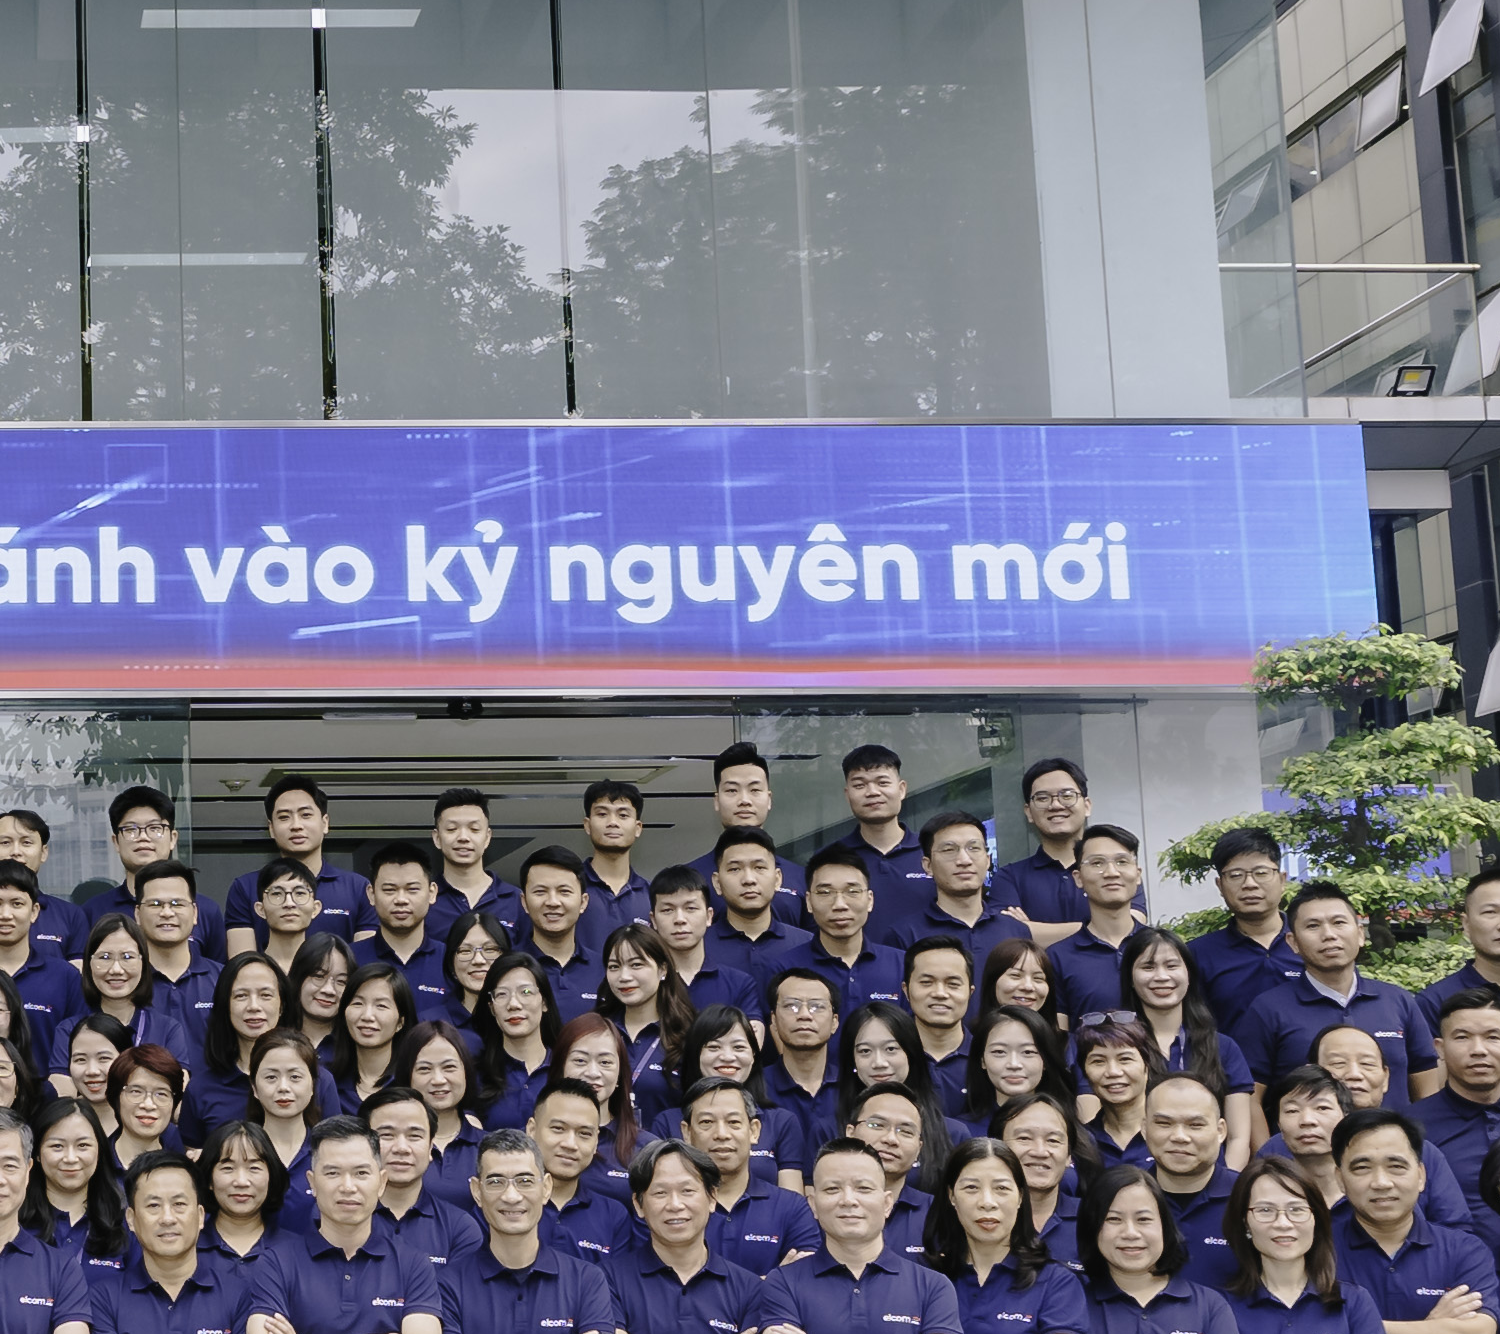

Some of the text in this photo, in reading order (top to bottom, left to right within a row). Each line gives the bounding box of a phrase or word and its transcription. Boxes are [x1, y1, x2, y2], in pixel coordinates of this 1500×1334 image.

[184, 526, 375, 605] vào
[405, 520, 518, 623] kỷ
[548, 523, 920, 624] nguyên
[952, 522, 1131, 602] mới
[744, 1233, 771, 1242] elcom
[577, 1239, 603, 1250] elcom
[1416, 1287, 1446, 1296] elcom
[19, 1295, 46, 1305] elcom
[371, 1296, 397, 1306] elcom
[882, 1313, 912, 1323] elcom
[996, 1312, 1023, 1322] elcom
[540, 1318, 567, 1327] elcom
[708, 1318, 735, 1331] elcom
